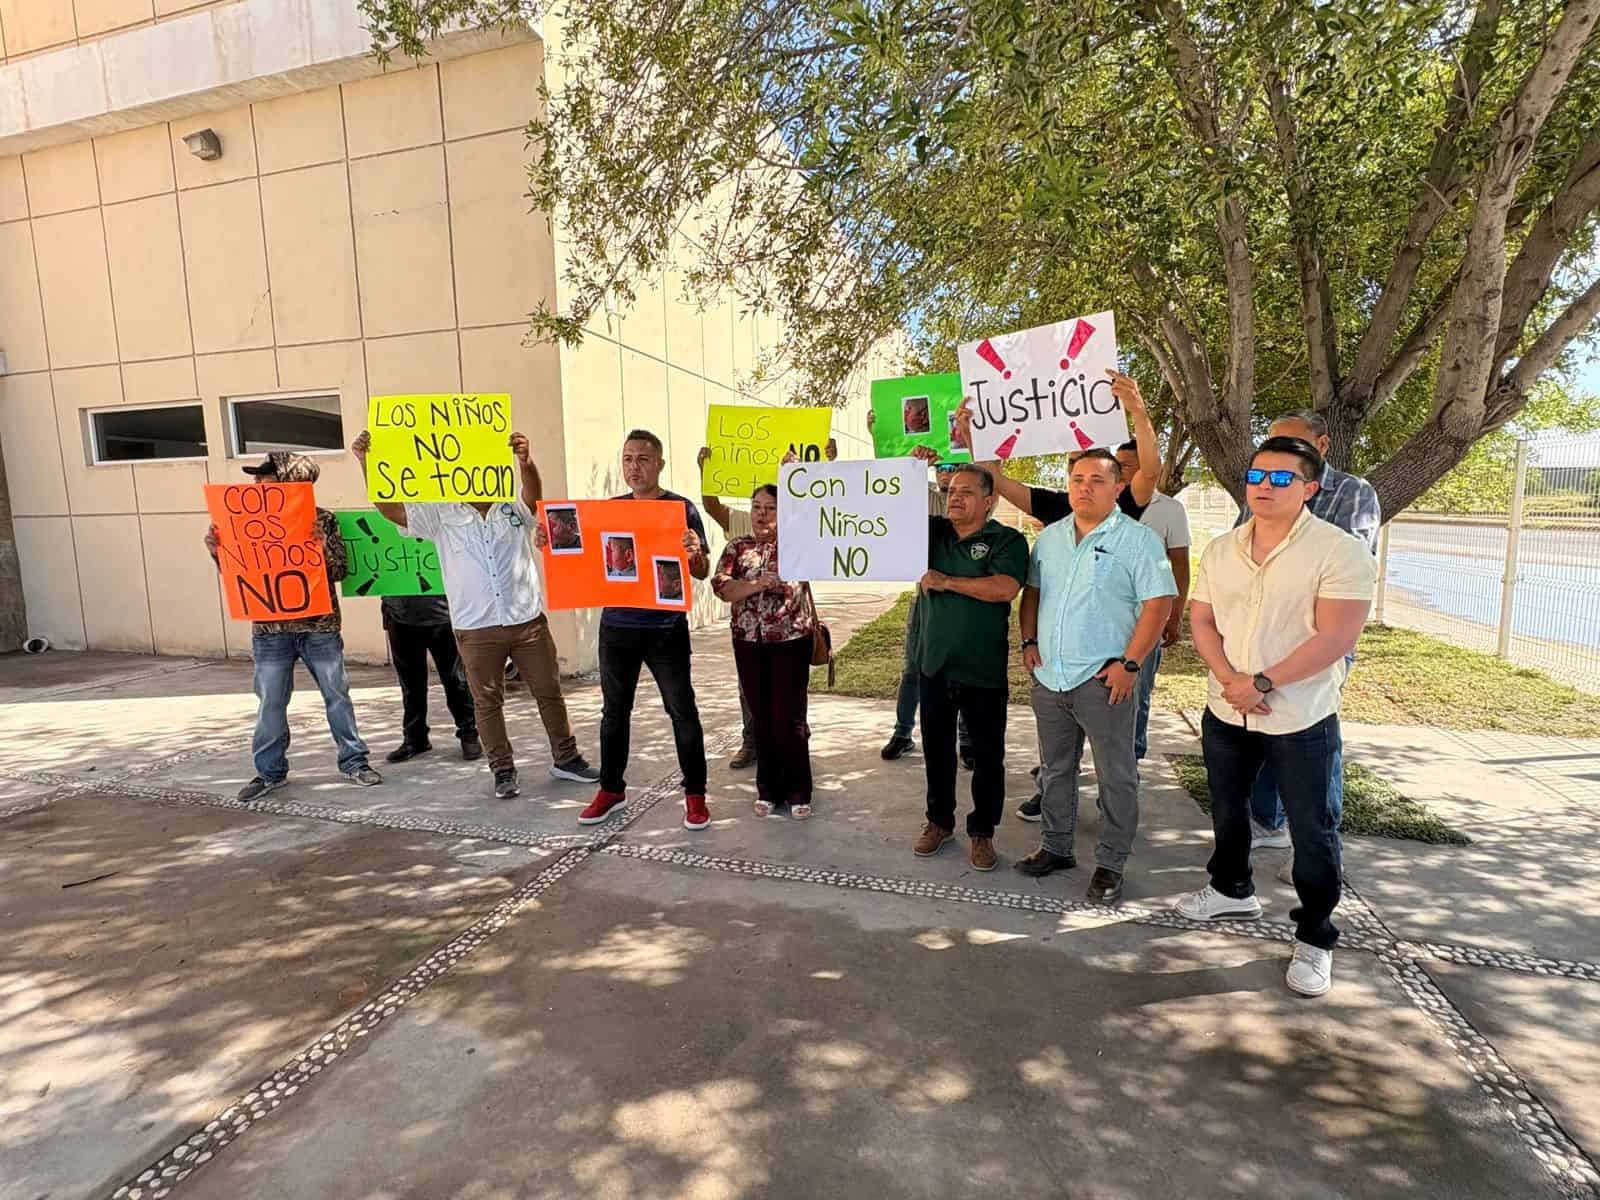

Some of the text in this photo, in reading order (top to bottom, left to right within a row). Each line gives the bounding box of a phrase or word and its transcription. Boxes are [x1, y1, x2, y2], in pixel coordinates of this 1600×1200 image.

[375, 401, 417, 428] LOS
[969, 374, 1121, 430] Justicia
[413, 432, 462, 463] NO
[377, 461, 515, 500] Se tocan
[712, 470, 741, 495] Se
[787, 467, 846, 499] Con
[864, 469, 902, 496] los
[819, 506, 889, 539] Niños
[221, 540, 323, 572] Niños
[342, 538, 439, 577] Justic
[833, 546, 869, 578] NO
[236, 569, 311, 616] NO
